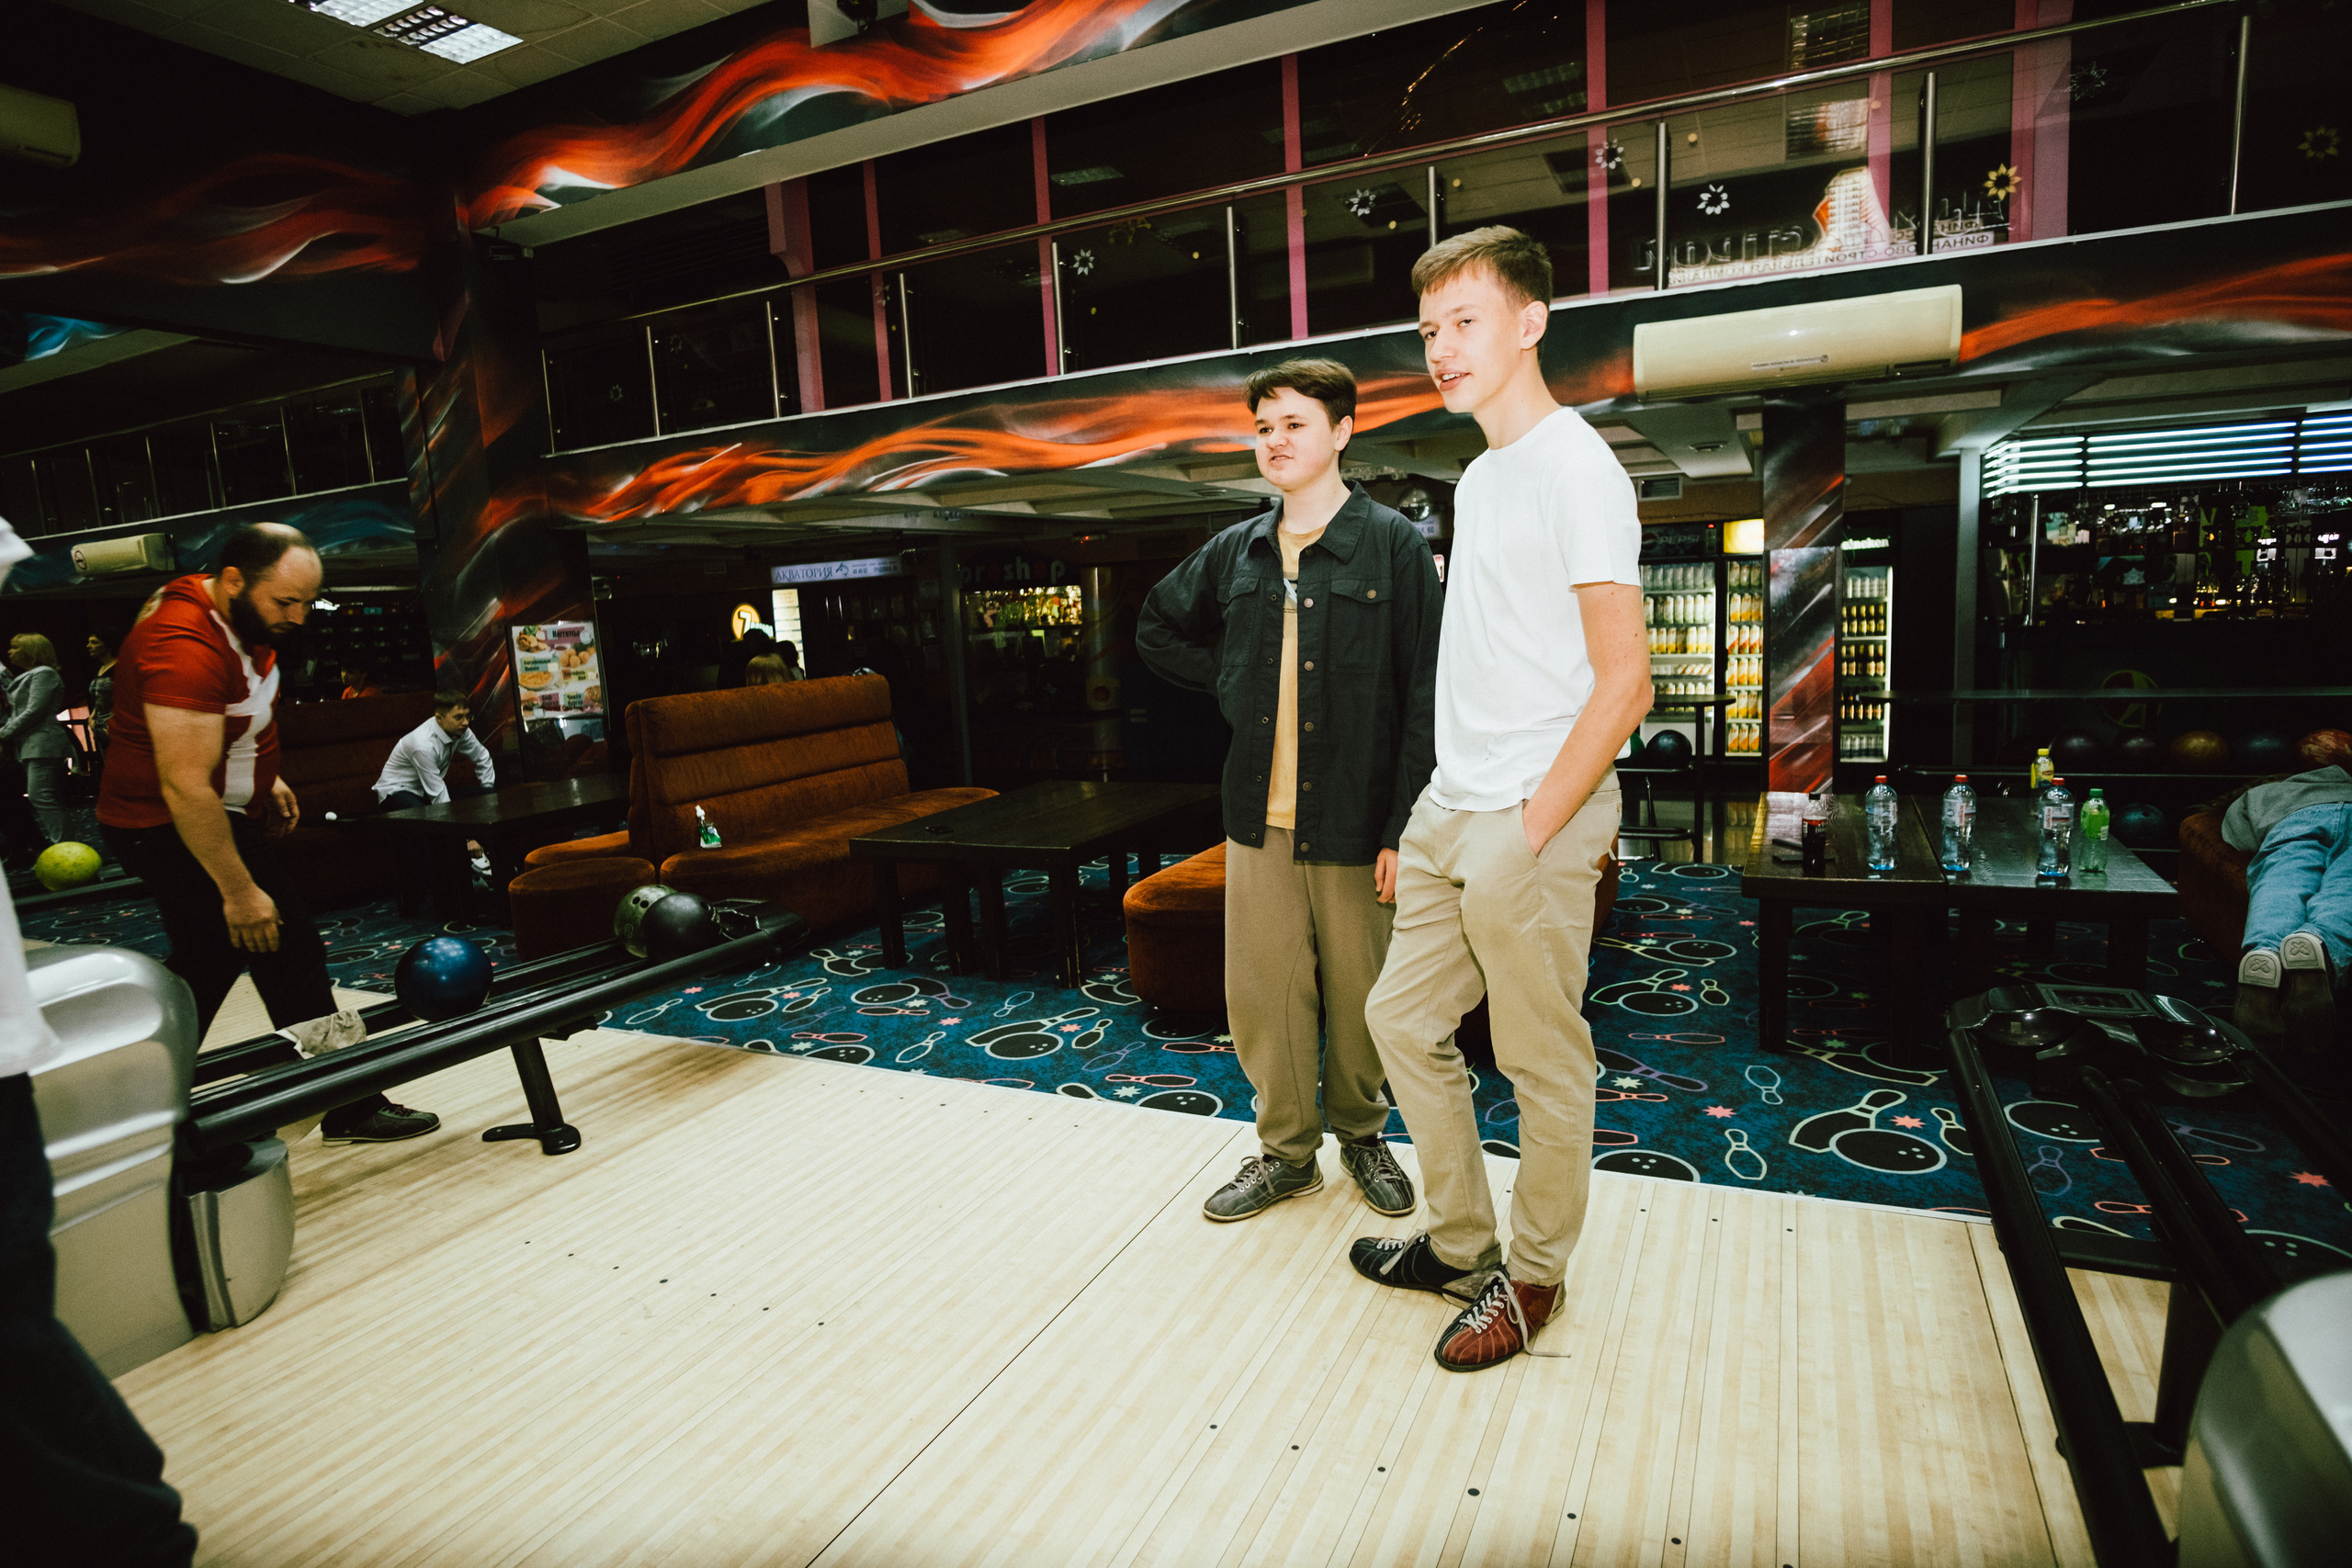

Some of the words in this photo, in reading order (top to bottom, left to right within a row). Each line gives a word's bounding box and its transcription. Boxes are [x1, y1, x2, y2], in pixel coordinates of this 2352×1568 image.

[1659, 535, 1700, 545] PEPSI
[1840, 536, 1890, 551] eineken
[775, 566, 832, 581] АКВАТОРИЯ
